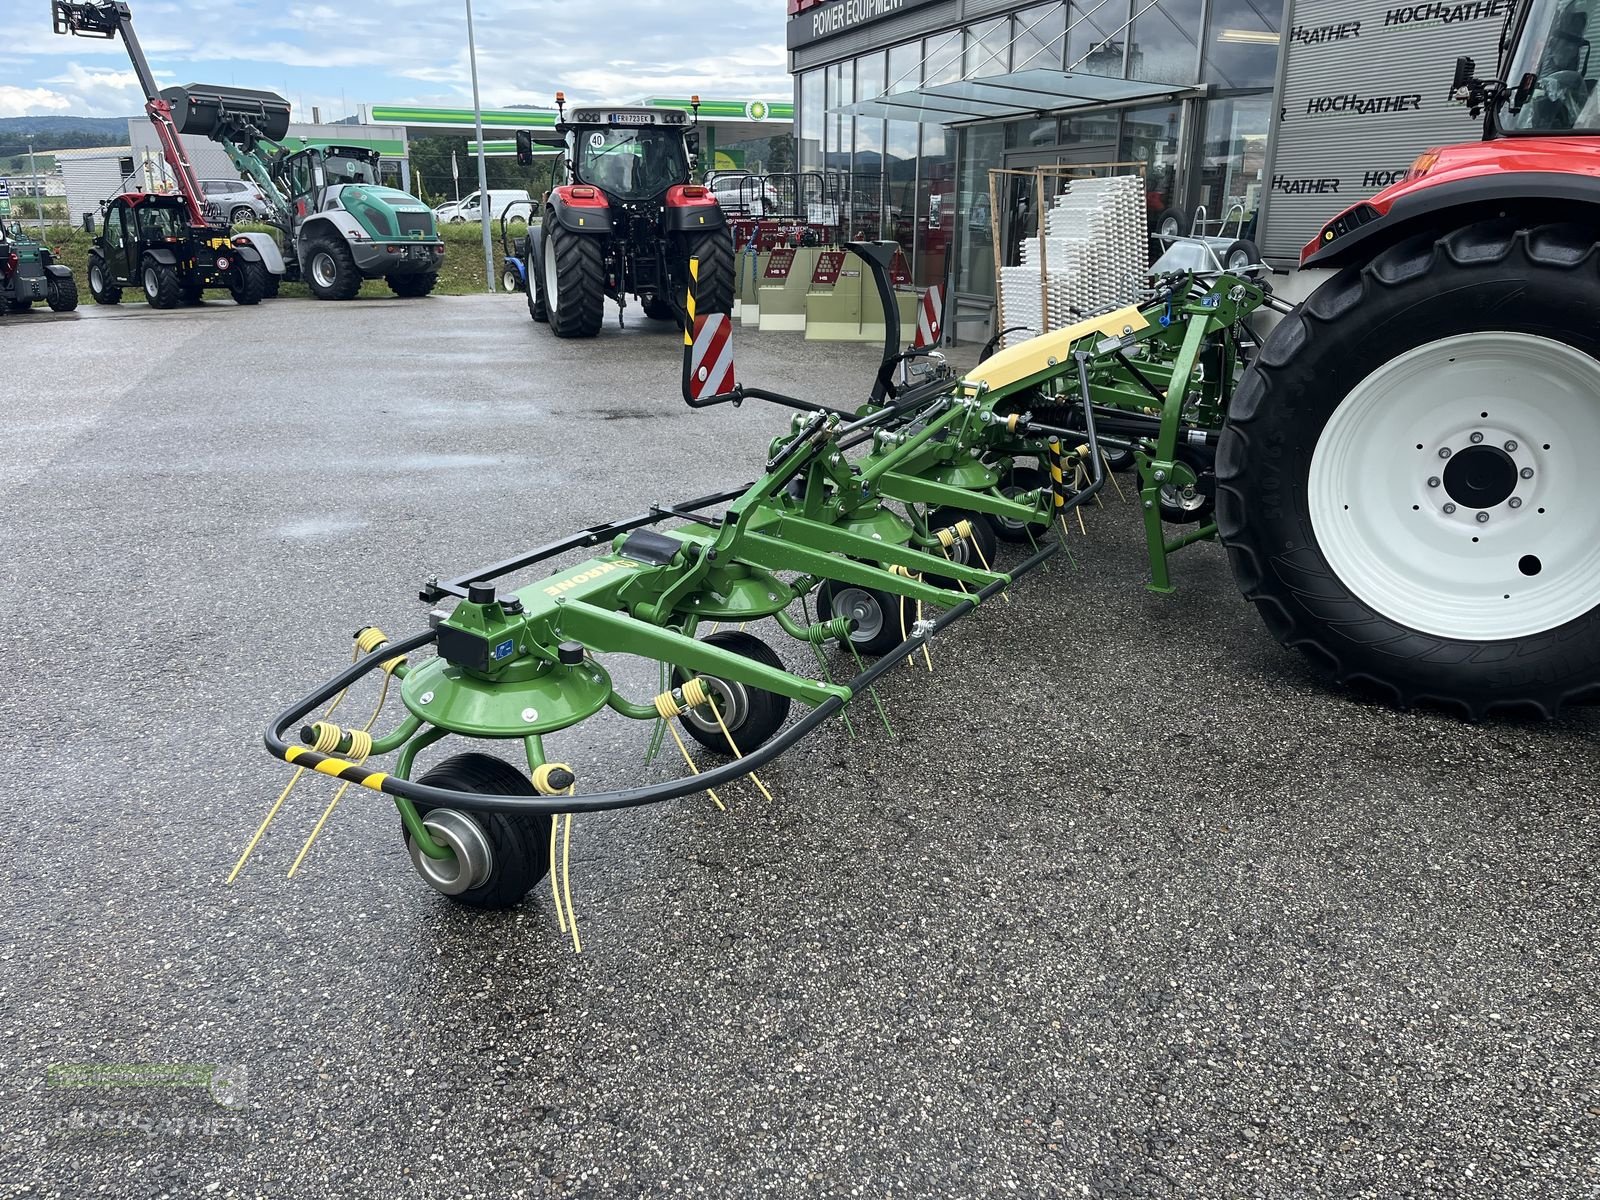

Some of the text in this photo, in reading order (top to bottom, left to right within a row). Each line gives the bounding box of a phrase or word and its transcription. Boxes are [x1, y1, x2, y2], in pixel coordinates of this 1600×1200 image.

[813, 4, 844, 37] POWER
[846, 0, 903, 26] EQUIPME
[1384, 0, 1510, 26] HOCHRATHE
[1307, 94, 1422, 115] HOCHRATHER
[592, 135, 601, 146] 40
[542, 562, 616, 597] KRONE
